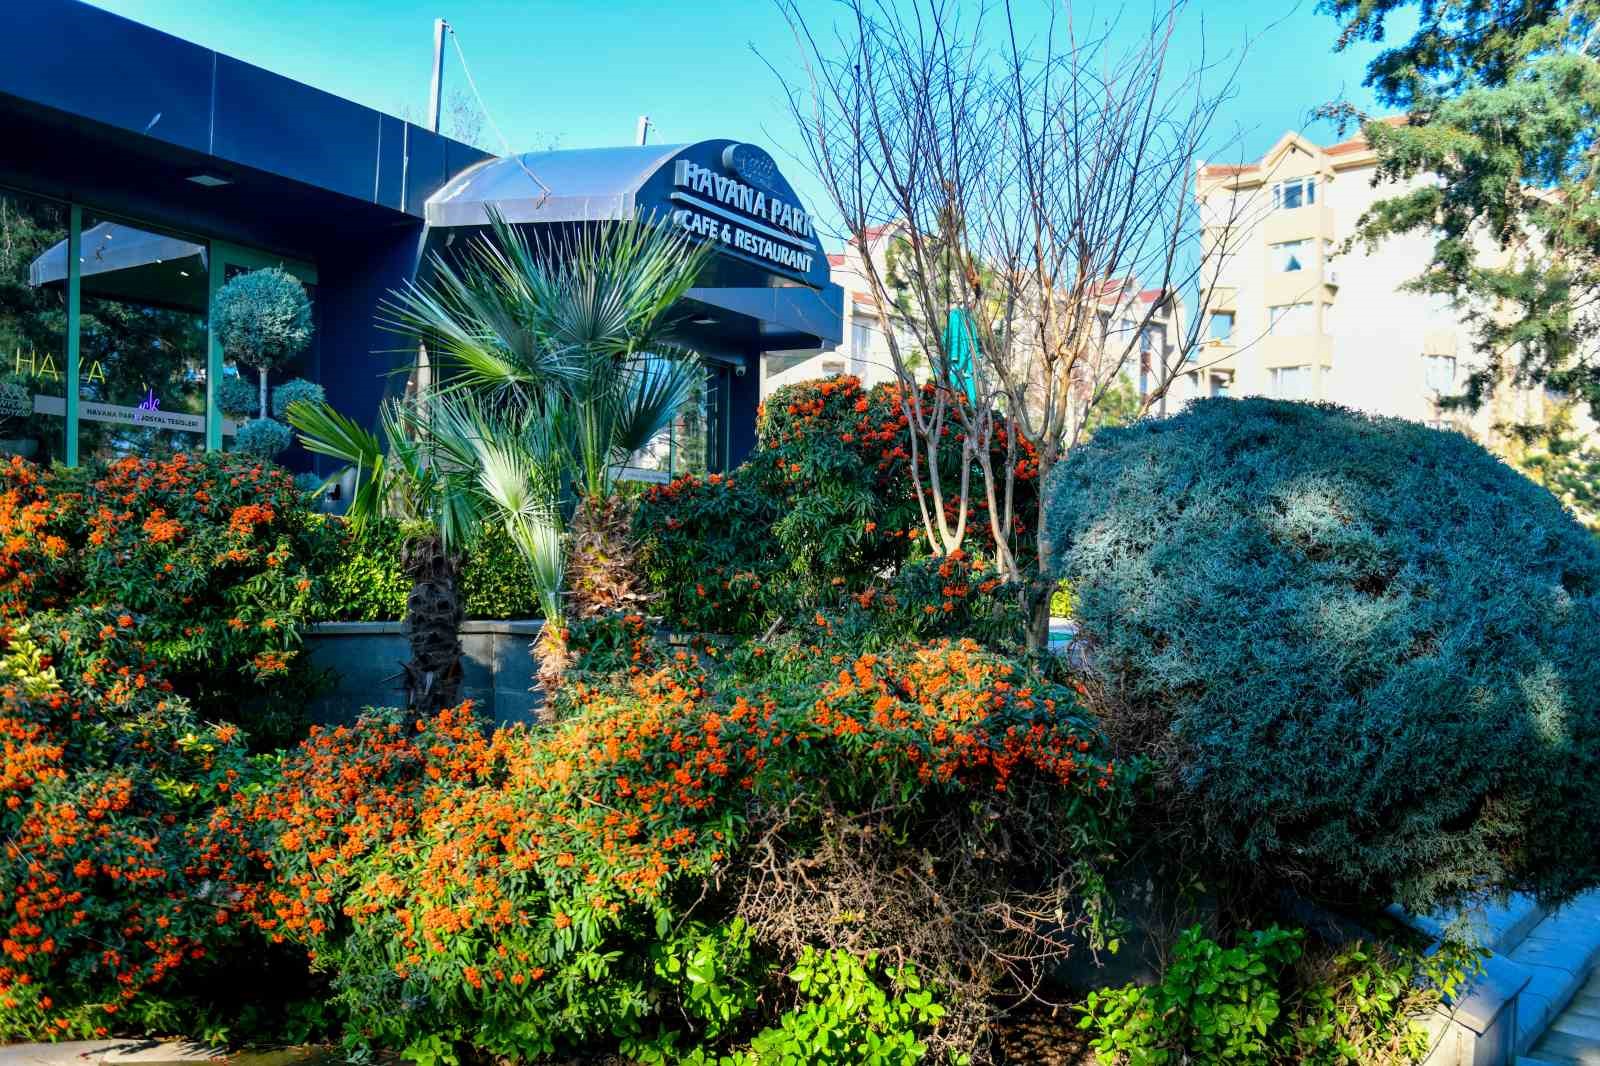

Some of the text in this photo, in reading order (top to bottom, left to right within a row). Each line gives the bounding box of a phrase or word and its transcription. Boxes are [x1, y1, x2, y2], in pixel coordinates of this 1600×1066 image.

[676, 160, 814, 238] HAVANA PARK
[675, 210, 813, 272] CAFE & RESTAURANT
